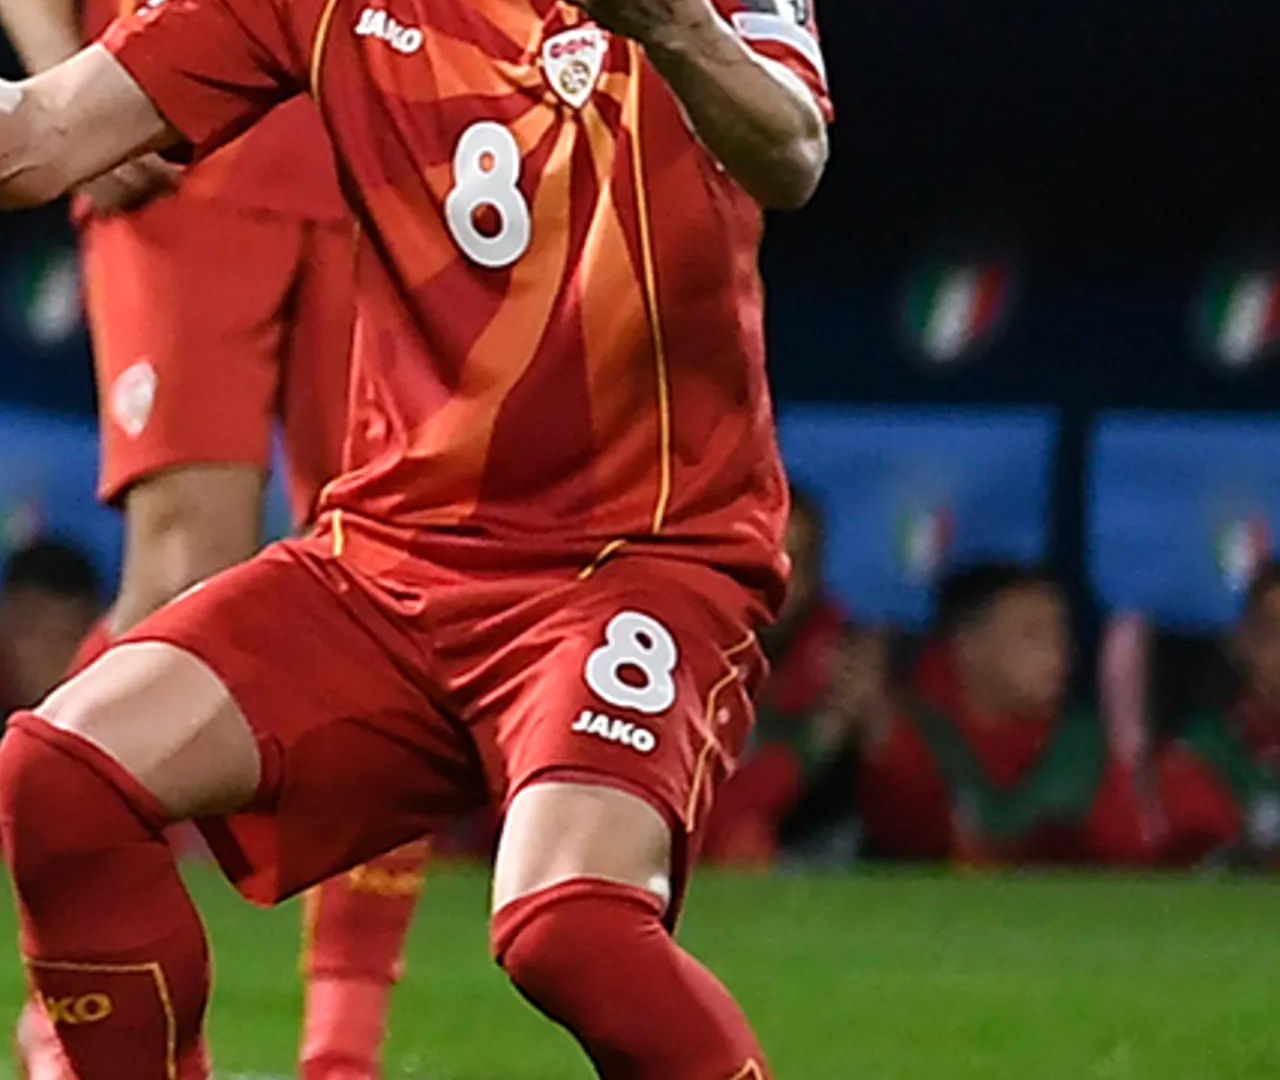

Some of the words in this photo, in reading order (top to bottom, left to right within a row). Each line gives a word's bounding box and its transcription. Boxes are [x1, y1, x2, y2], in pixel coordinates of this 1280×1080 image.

[354, 7, 424, 54] JAKO
[445, 120, 531, 269] 8
[585, 610, 678, 714] 8
[571, 710, 657, 752] JAKO
[45, 992, 113, 1025] KO
